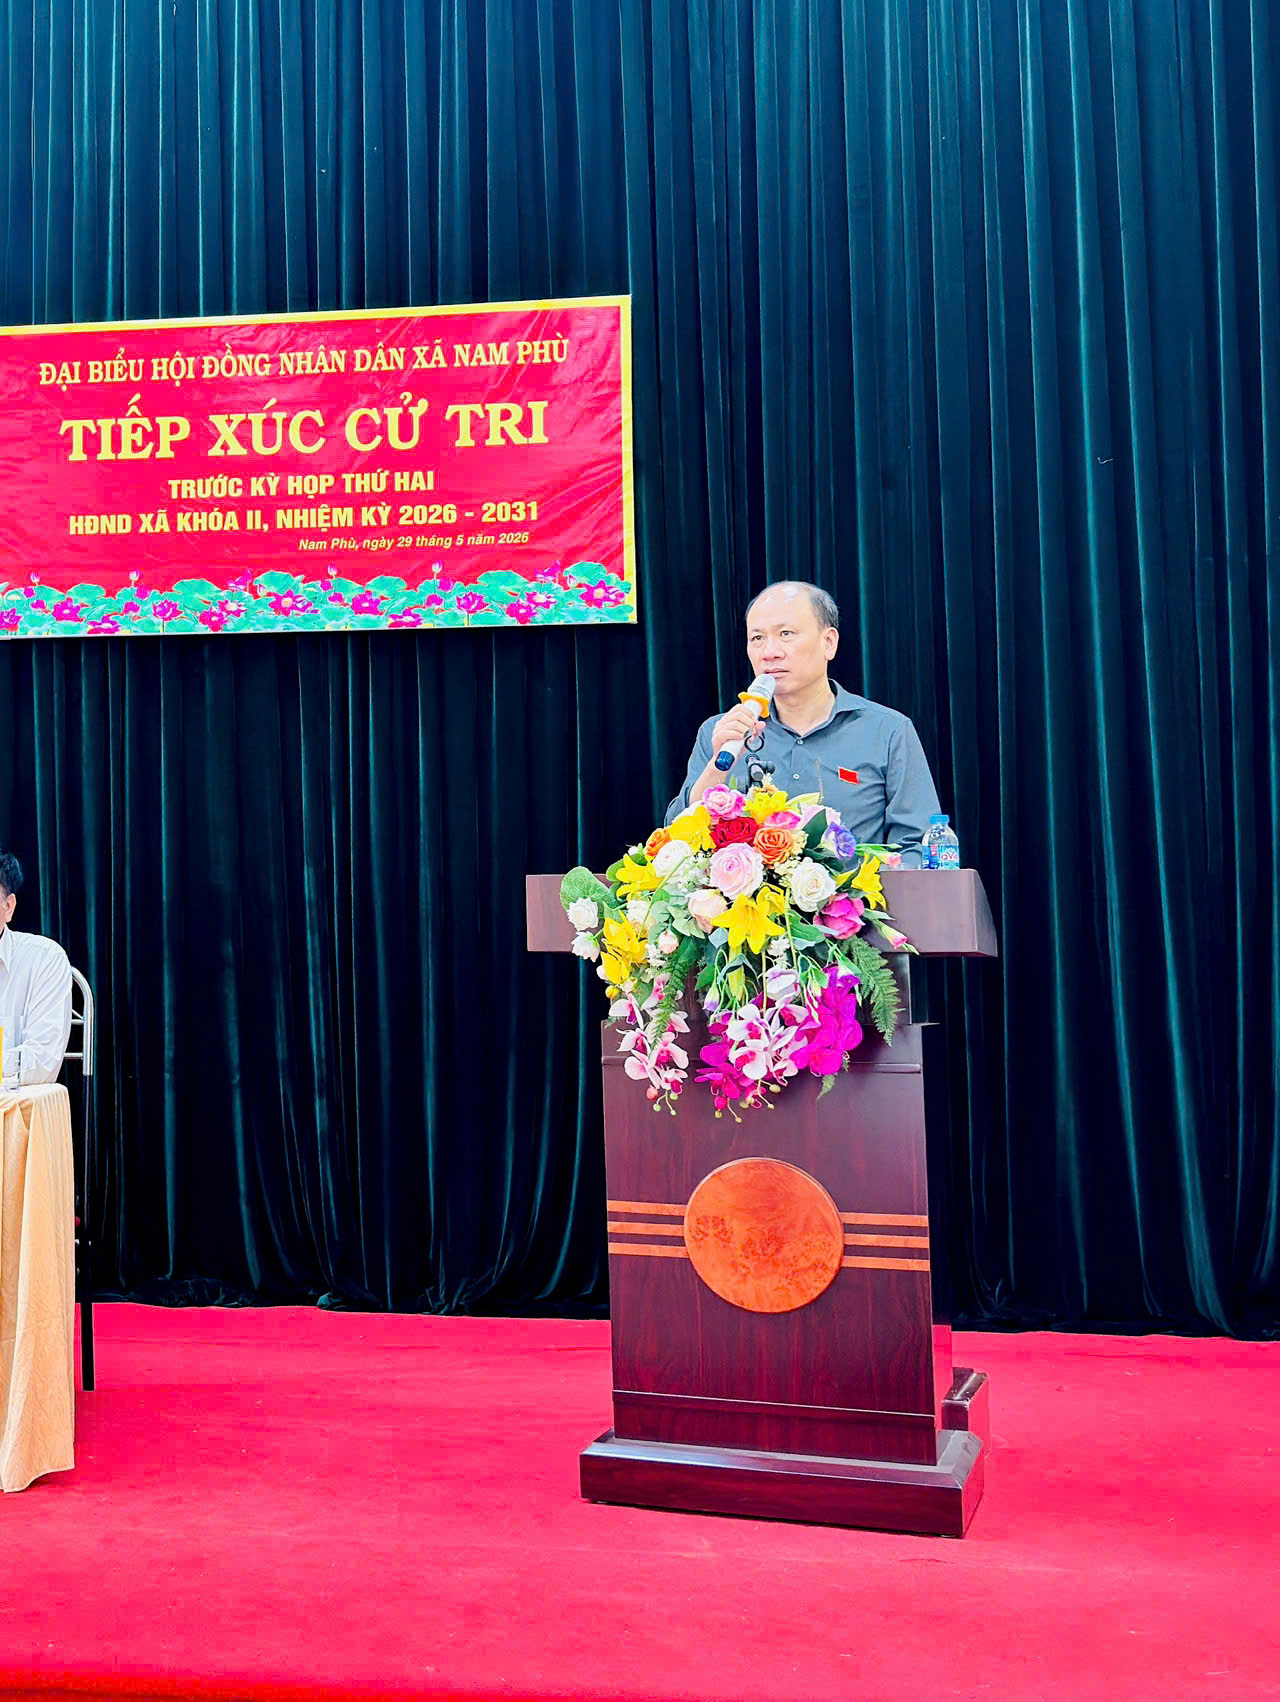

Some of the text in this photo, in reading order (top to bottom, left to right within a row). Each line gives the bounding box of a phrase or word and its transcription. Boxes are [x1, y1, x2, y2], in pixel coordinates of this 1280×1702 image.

[39, 332, 569, 392] ĐẠI BIỂU HỘI ĐỒNG NHÂN DÂN XÃ NAM PHÙ
[59, 391, 549, 461] TIẾP XÚC CỬ TRI
[167, 468, 434, 499] TRƯỚC KỲ HỌP THỨ HAI
[69, 514, 132, 535] HĐND
[139, 509, 170, 533] XÃ
[177, 507, 240, 532] KHÓA
[246, 510, 269, 532] II,
[276, 503, 353, 532] NHIỆM
[361, 501, 392, 527] KỲ
[398, 503, 457, 525] 2026
[481, 501, 538, 523] 2031
[299, 531, 529, 551] Nam Phù, ngày 29 tháng 5 năm 2026
